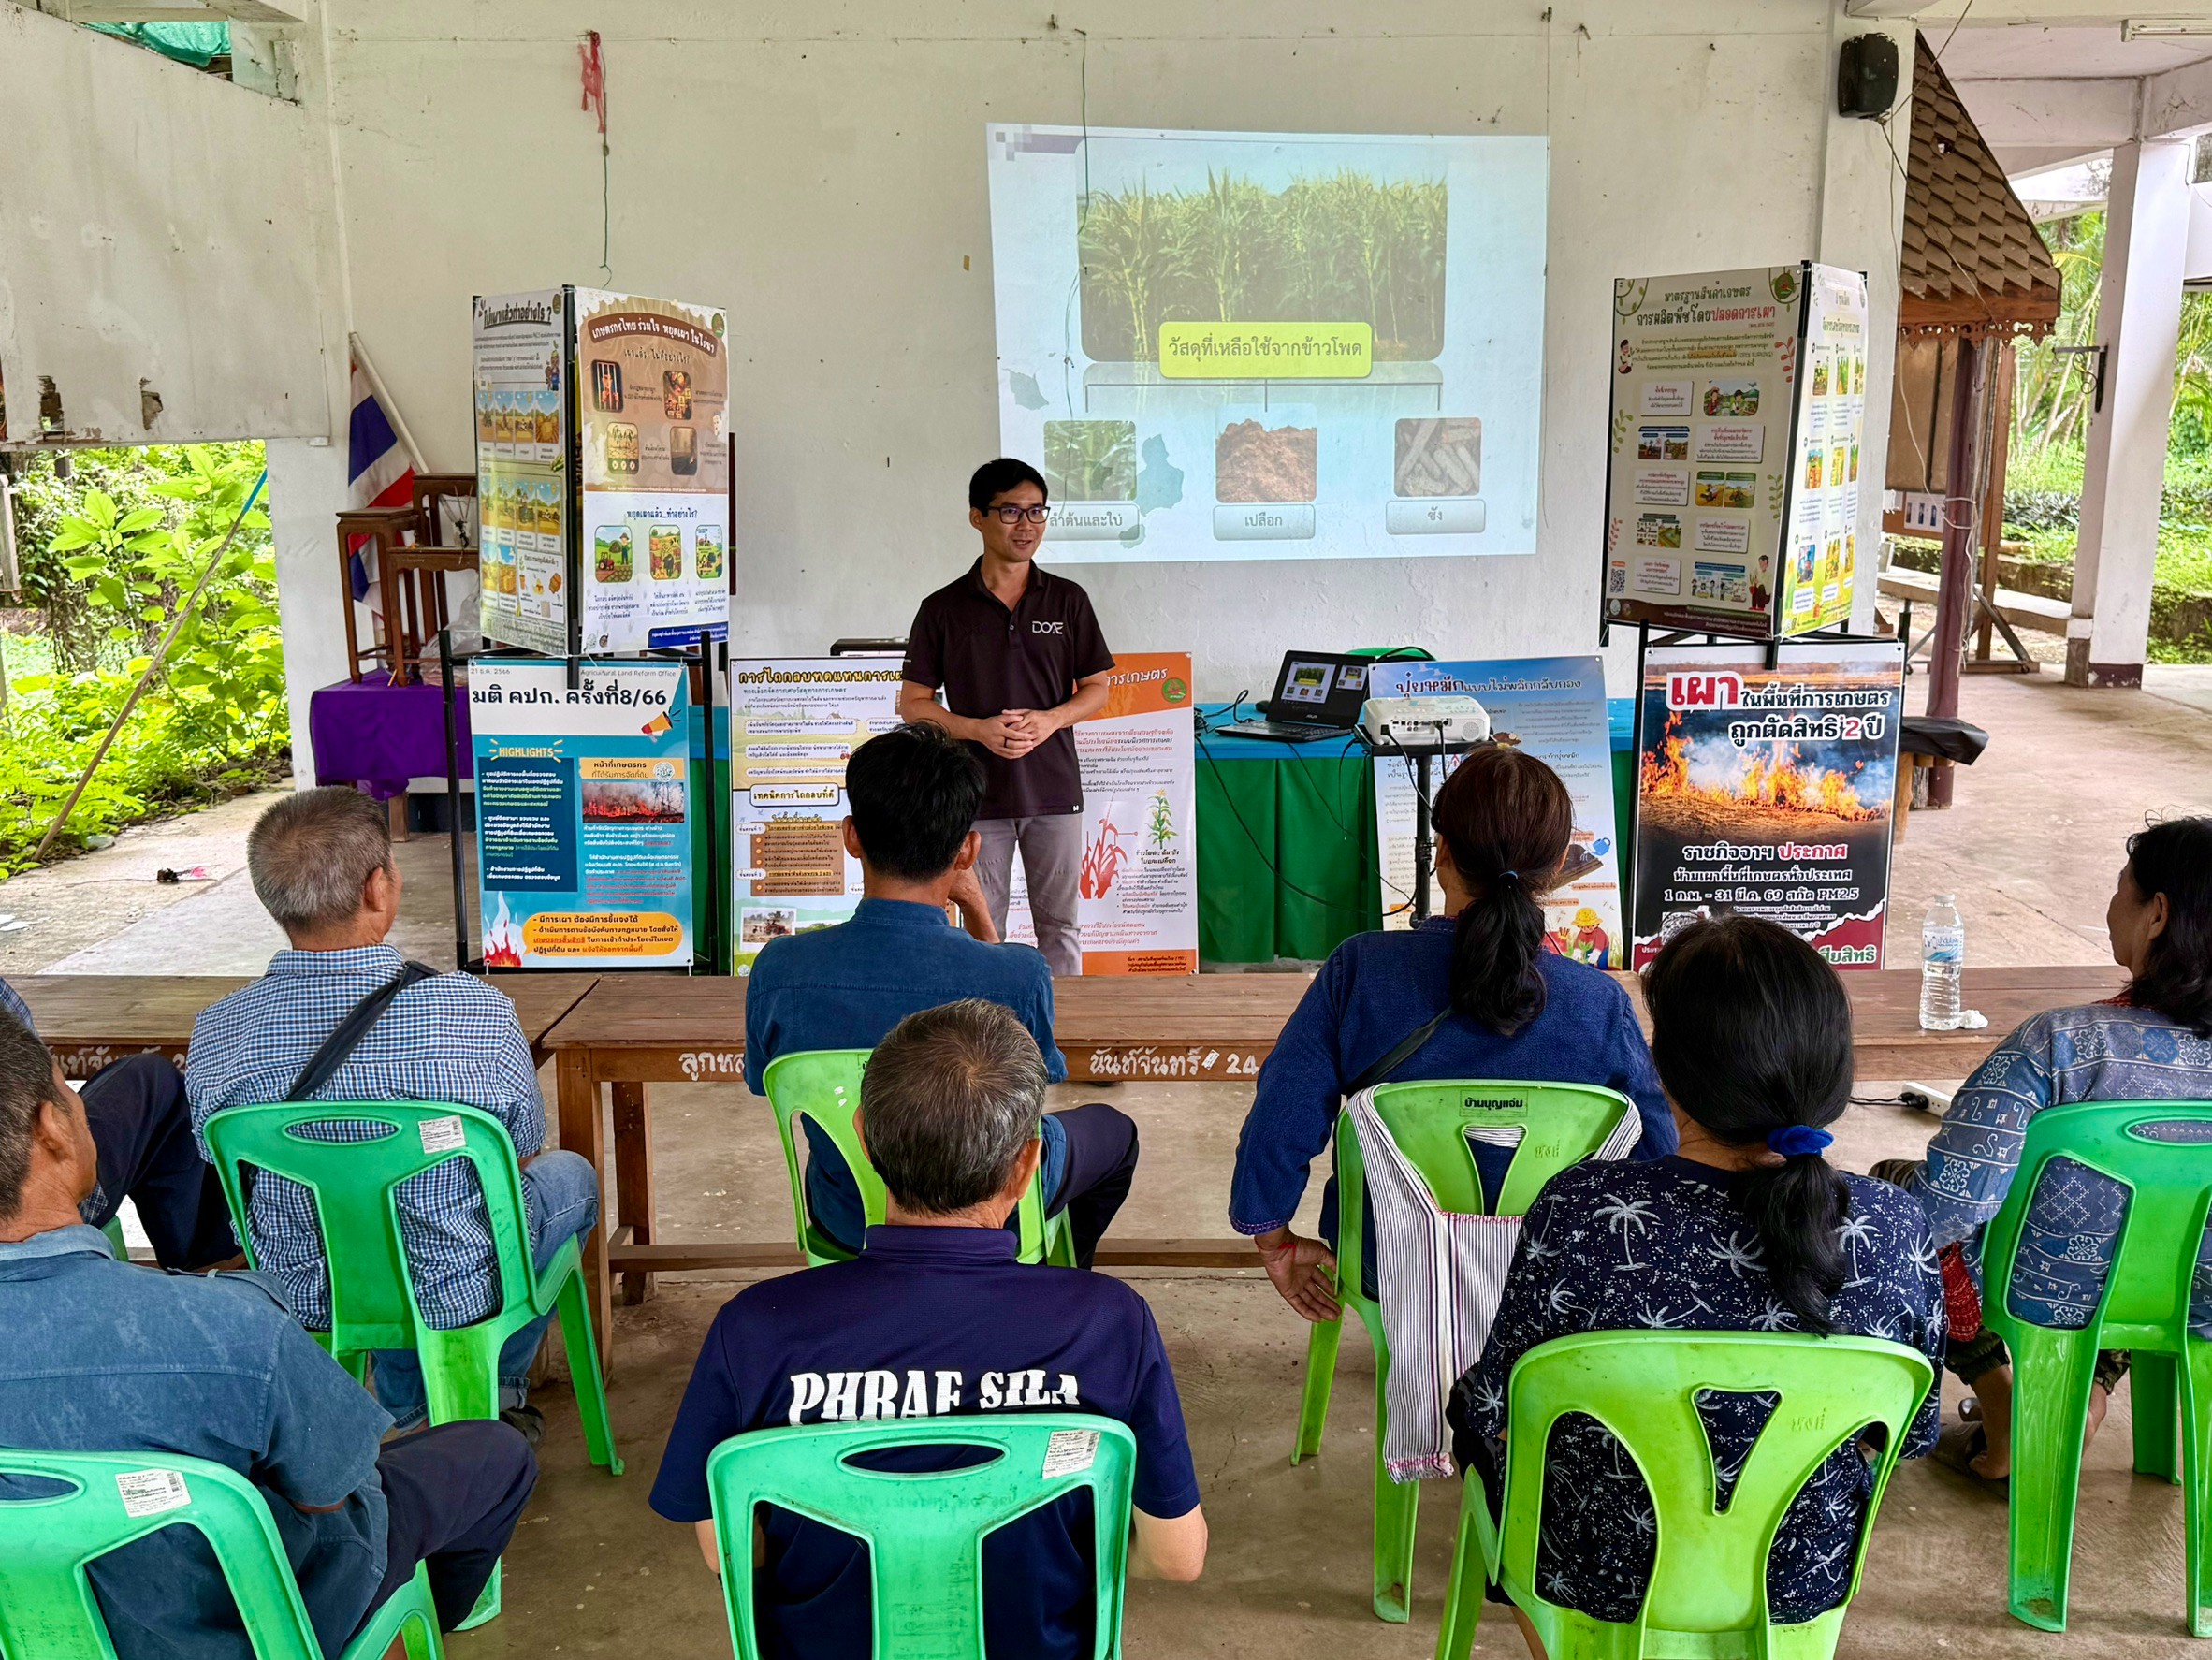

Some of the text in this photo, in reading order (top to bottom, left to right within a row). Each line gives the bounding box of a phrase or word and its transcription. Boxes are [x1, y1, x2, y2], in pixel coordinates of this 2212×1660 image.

[592, 317, 636, 339] เกษตรกรไทย
[1169, 333, 1361, 362] วัสดุที่เหลือใช้จากข้าวโพด
[1245, 512, 1283, 527] เปลือก
[473, 678, 667, 707] มติ คปก. ครั้งที่8/66
[1671, 676, 1890, 707] เผา ในพื้นที่การเกษตร
[1845, 720, 1859, 736] 2
[1867, 715, 1882, 736] ปี
[499, 748, 554, 758] HIGHLIGHTS
[593, 759, 647, 768] หน้าที่เกษตรกร
[1683, 842, 1848, 860] ราชกิจจาฯ ประกาศ
[1674, 865, 1852, 882] ห้ามเผาพื้นที่เกษตรทั่วประเทศ
[1665, 889, 1673, 901] 1
[1676, 890, 1702, 901] ก.พ.
[1715, 889, 1732, 901] 31
[1735, 888, 1761, 901] มี.ค.
[1764, 890, 1783, 901] 69
[1786, 887, 1814, 901] สกัด
[1817, 888, 1859, 901] PM2.5
[1226, 1053, 1259, 1075] 24
[1464, 1097, 1524, 1111] บ้านบุญแจ่ม
[979, 1370, 1080, 1409] SILA
